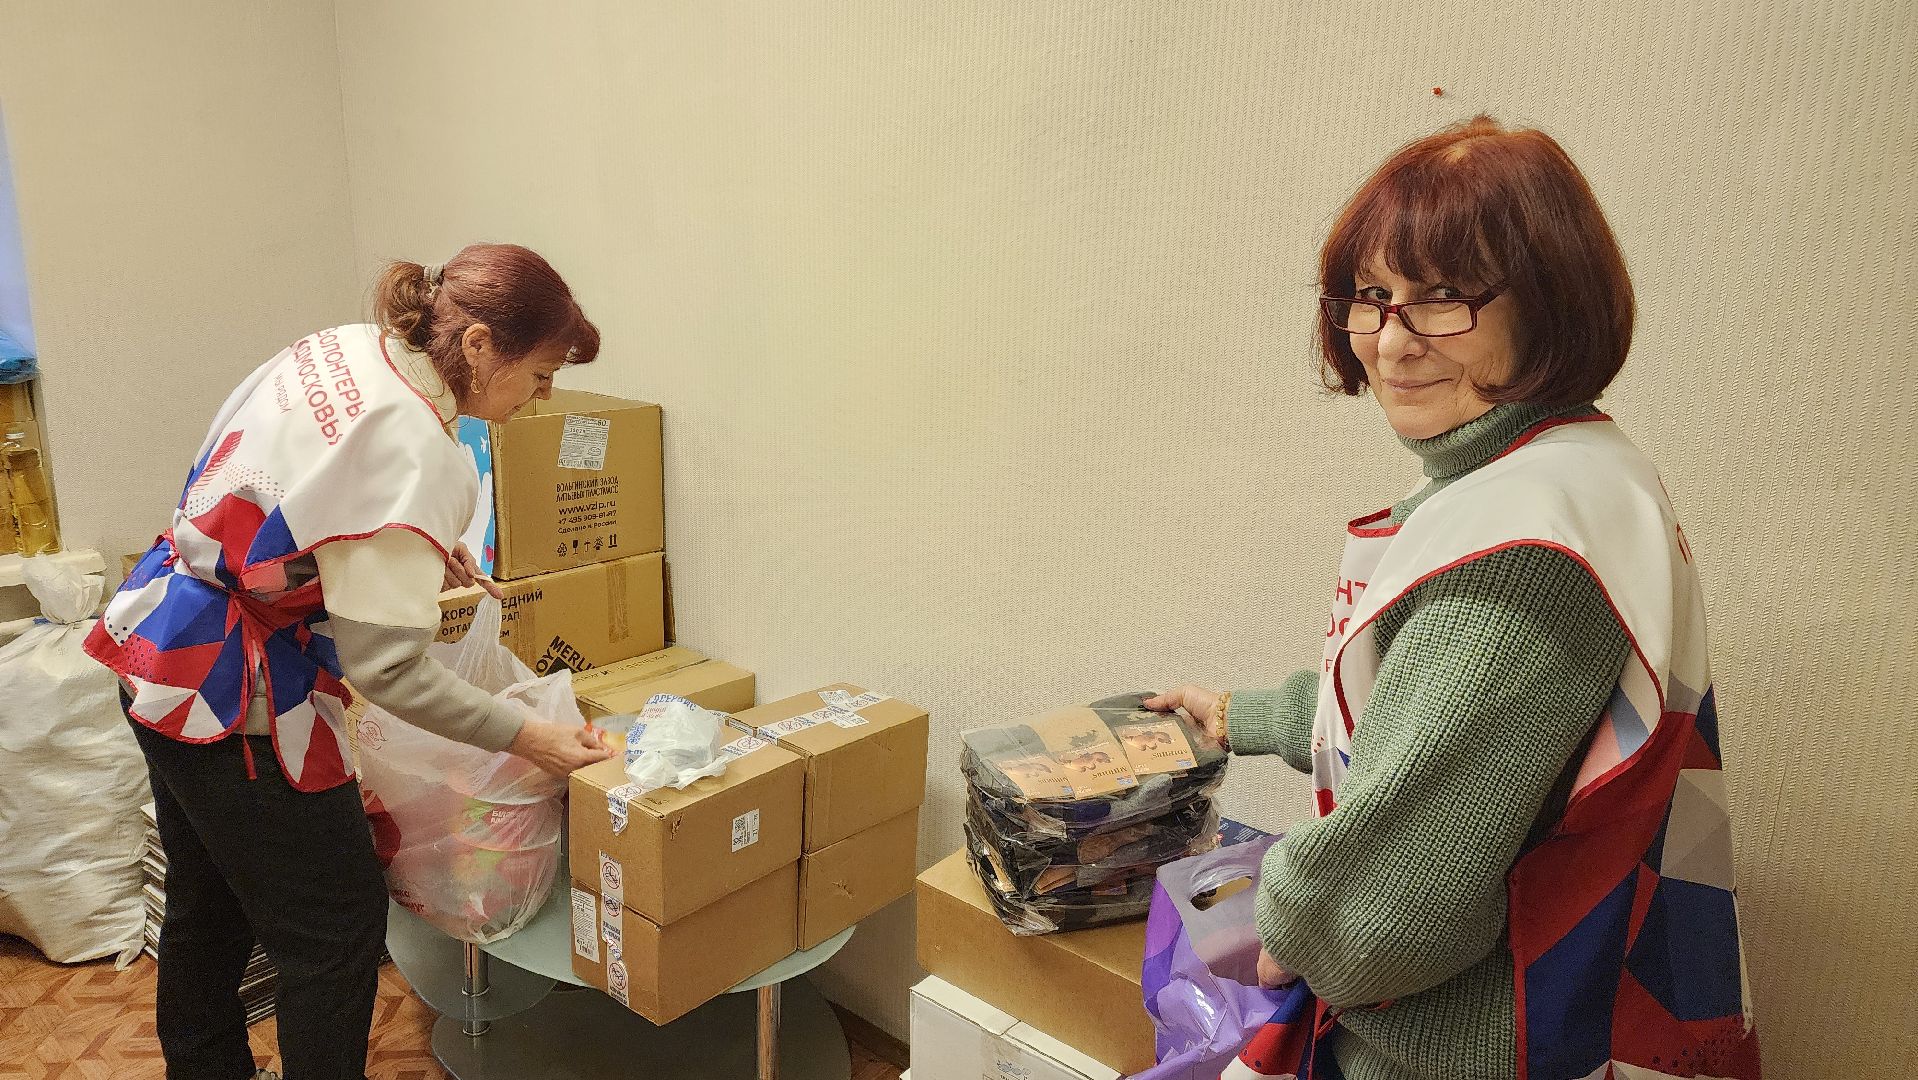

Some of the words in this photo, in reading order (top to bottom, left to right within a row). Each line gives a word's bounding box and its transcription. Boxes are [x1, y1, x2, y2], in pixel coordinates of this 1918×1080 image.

[558, 500, 616, 515] www.vzlp.ru
[441, 604, 478, 622] КОРО
[501, 588, 543, 609] ЕДНИЙ
[501, 611, 520, 622] РАП
[549, 635, 598, 673] MERLI
